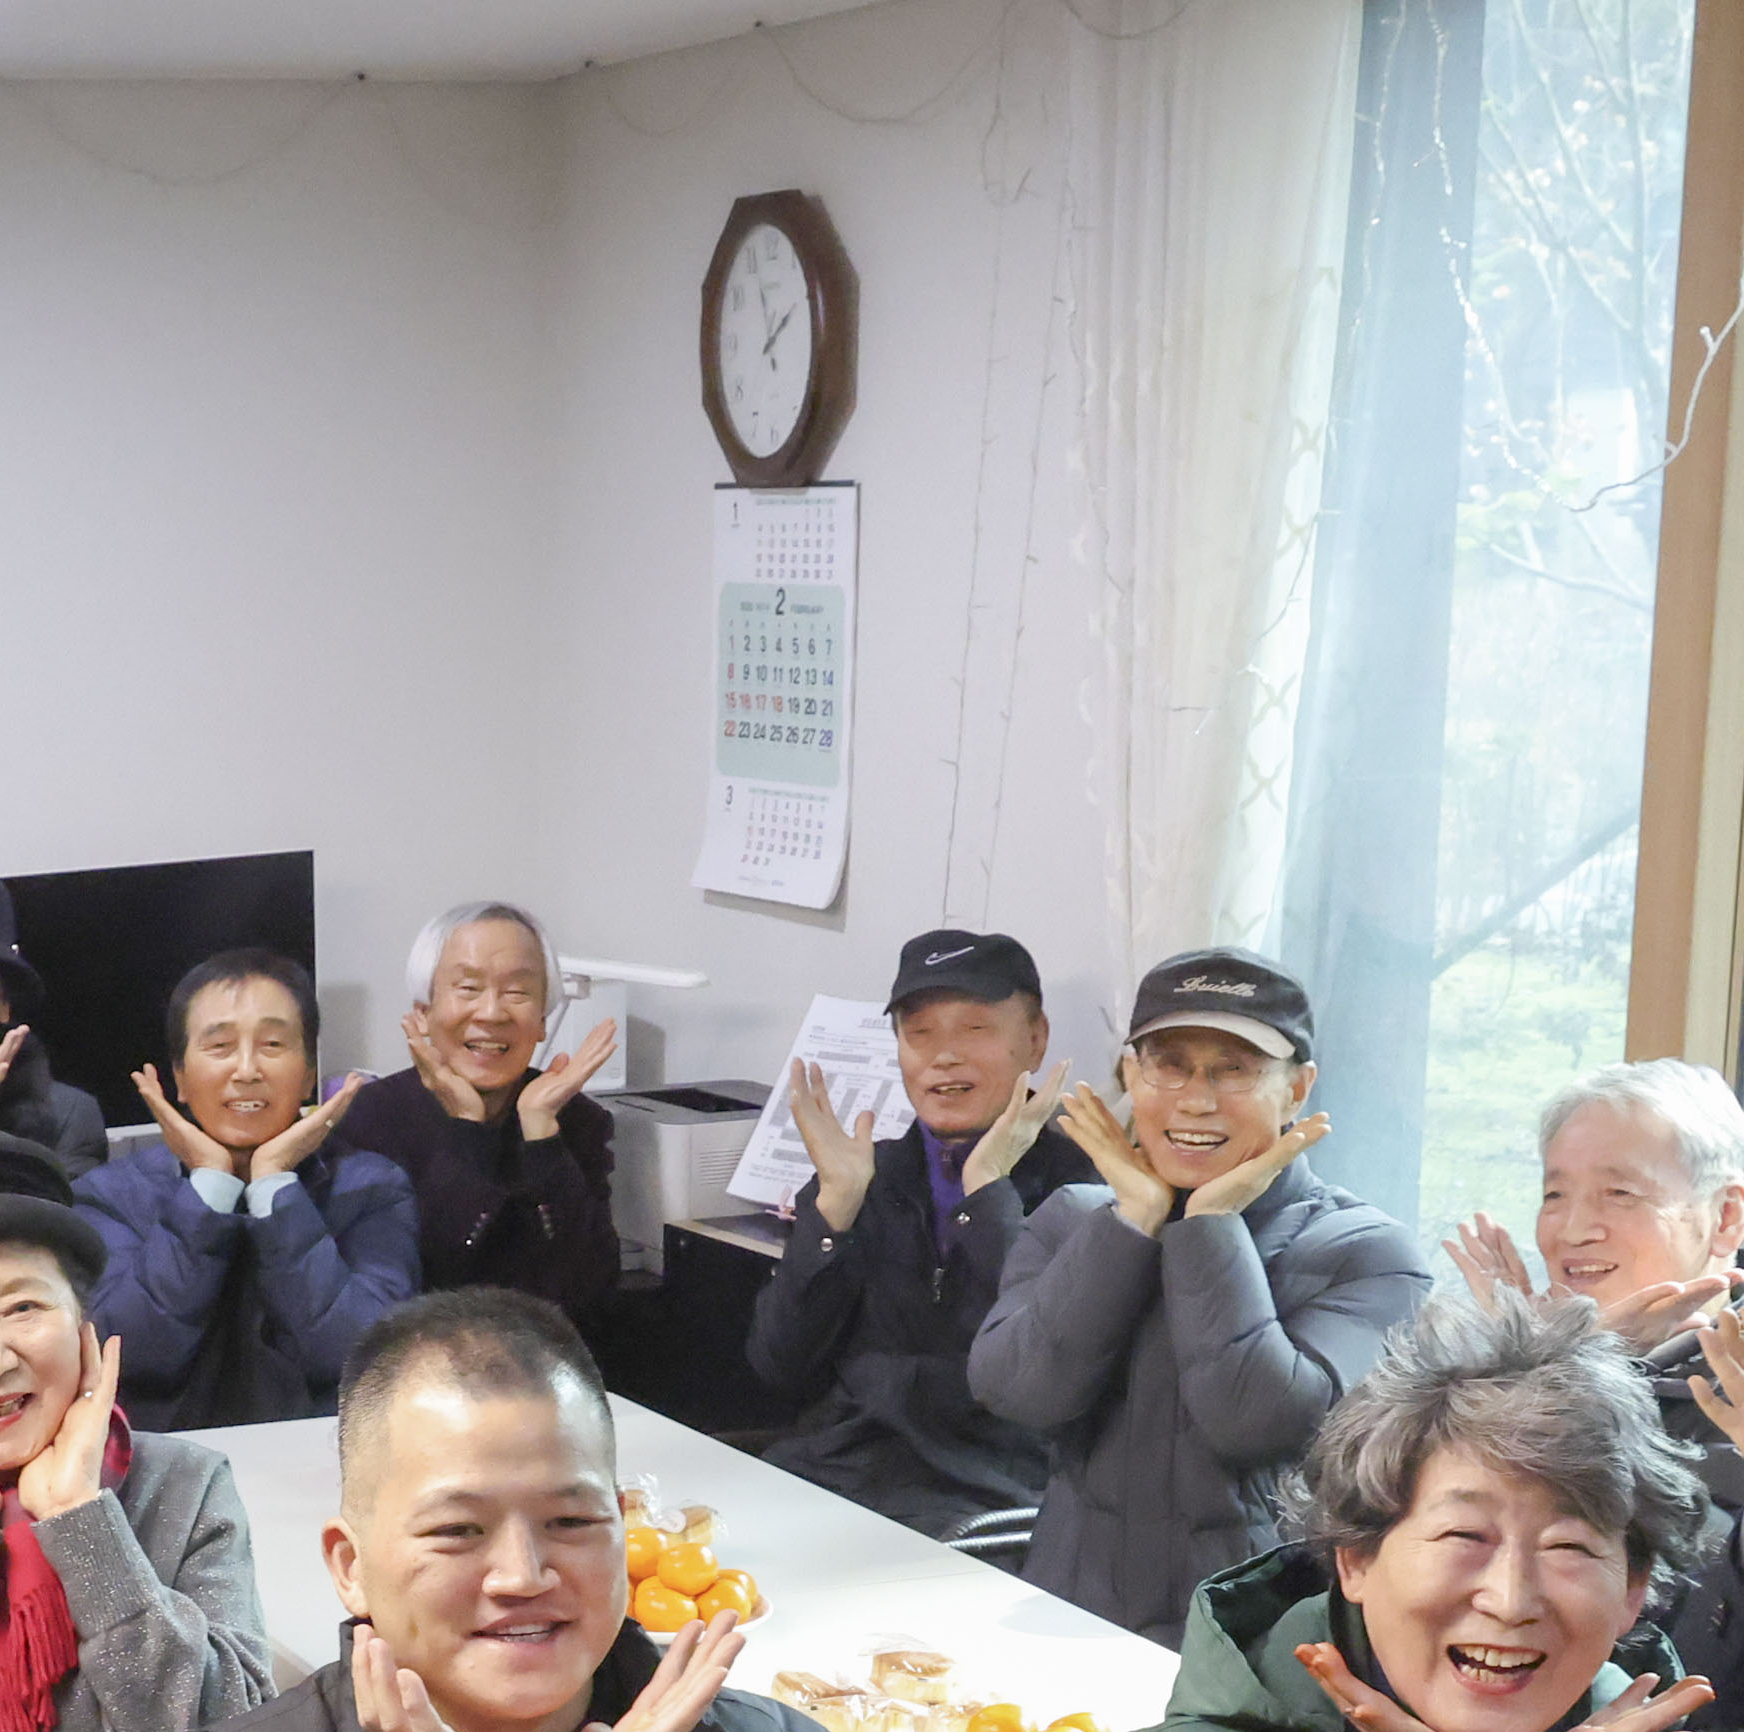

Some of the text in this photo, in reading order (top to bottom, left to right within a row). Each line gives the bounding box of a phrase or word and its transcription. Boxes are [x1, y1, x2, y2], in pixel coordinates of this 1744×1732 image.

[775, 587, 786, 615] 2
[729, 635, 832, 655] 1 2 3 4 5 6 7
[728, 663, 734, 679] 8
[743, 664, 750, 680] 9
[756, 665, 768, 682] 10
[773, 667, 783, 682] 11
[789, 667, 800, 684] 12
[805, 669, 817, 685] 13
[726, 692, 736, 709] 15
[756, 694, 767, 711] 17
[788, 697, 800, 714] 19
[804, 698, 816, 715] 20
[822, 700, 833, 717] 21
[724, 720, 833, 747] 22 23 24 25 26 27 28
